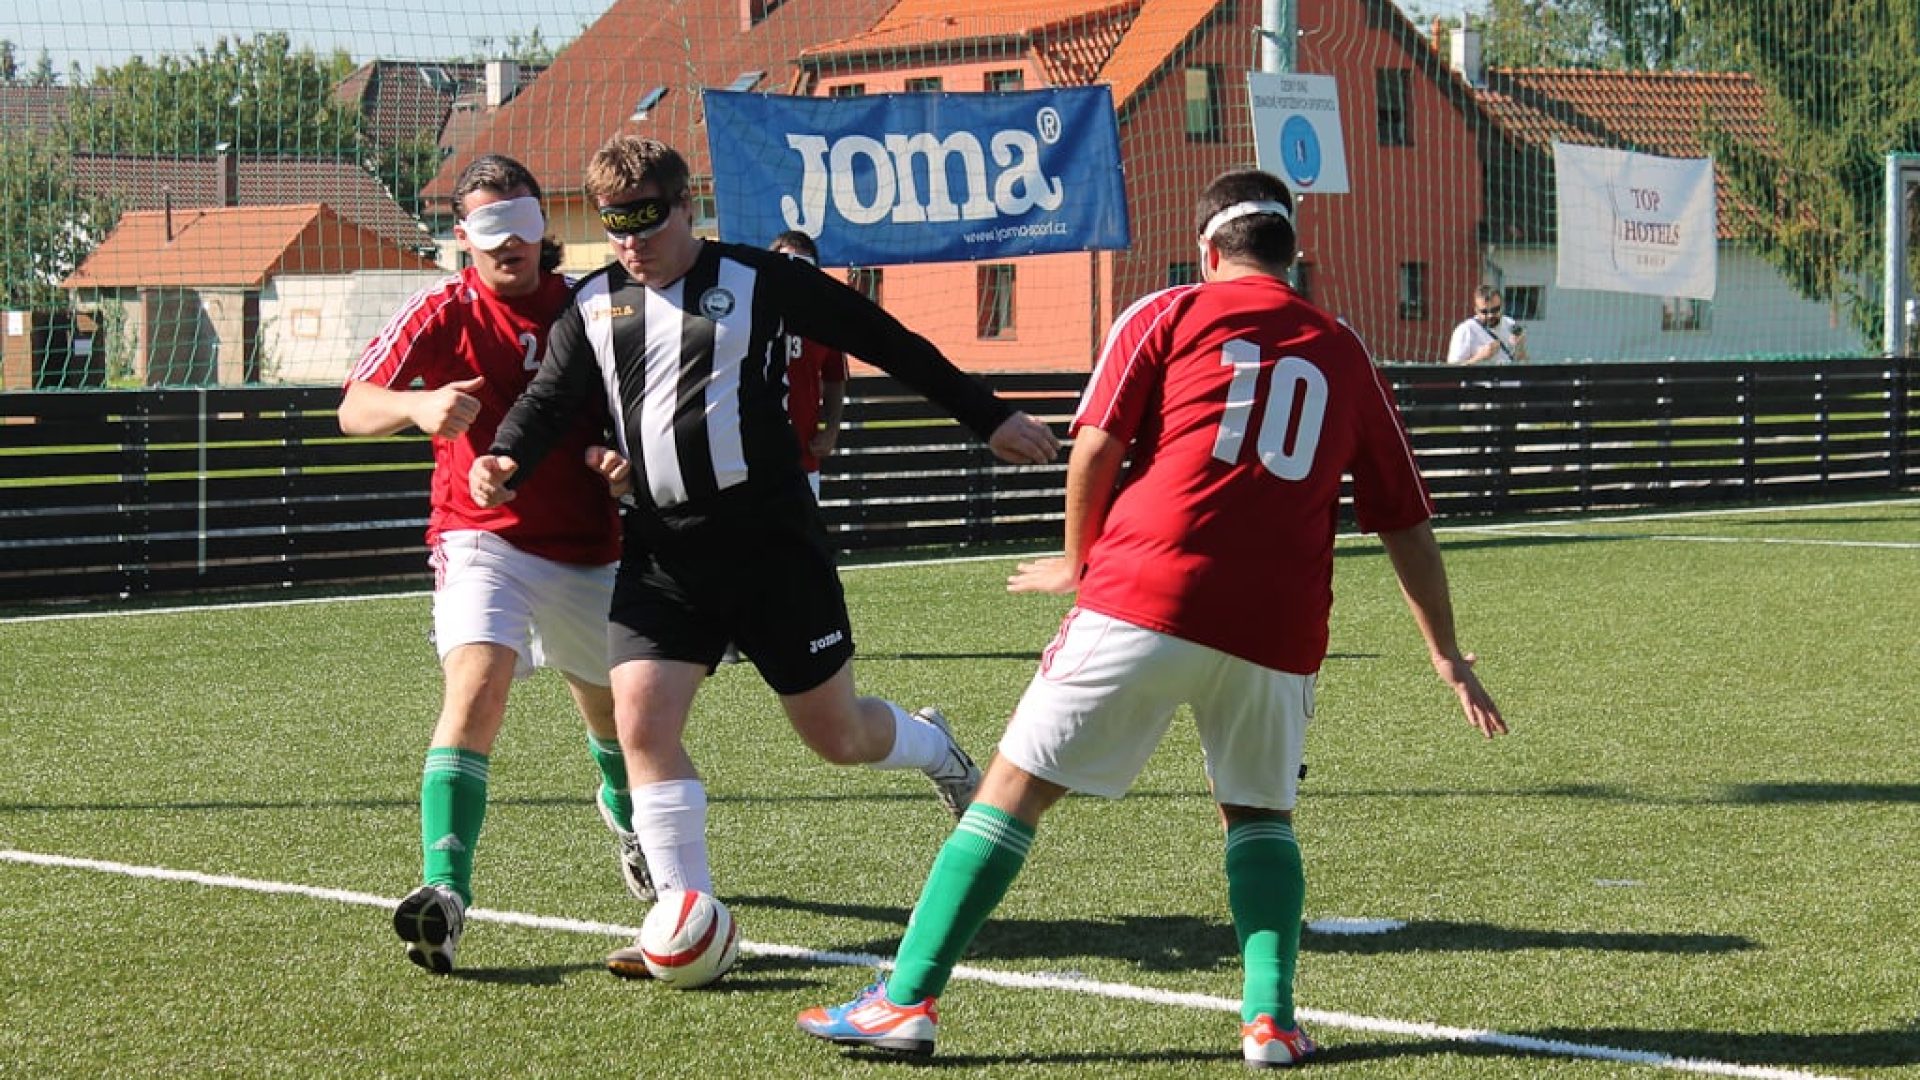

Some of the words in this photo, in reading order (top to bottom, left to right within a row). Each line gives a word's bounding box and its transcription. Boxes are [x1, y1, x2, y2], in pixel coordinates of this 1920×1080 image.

[1630, 188, 1660, 212] TOP
[1624, 219, 1680, 247] HOTELS
[519, 333, 541, 370] 2
[1212, 340, 1327, 480] 10
